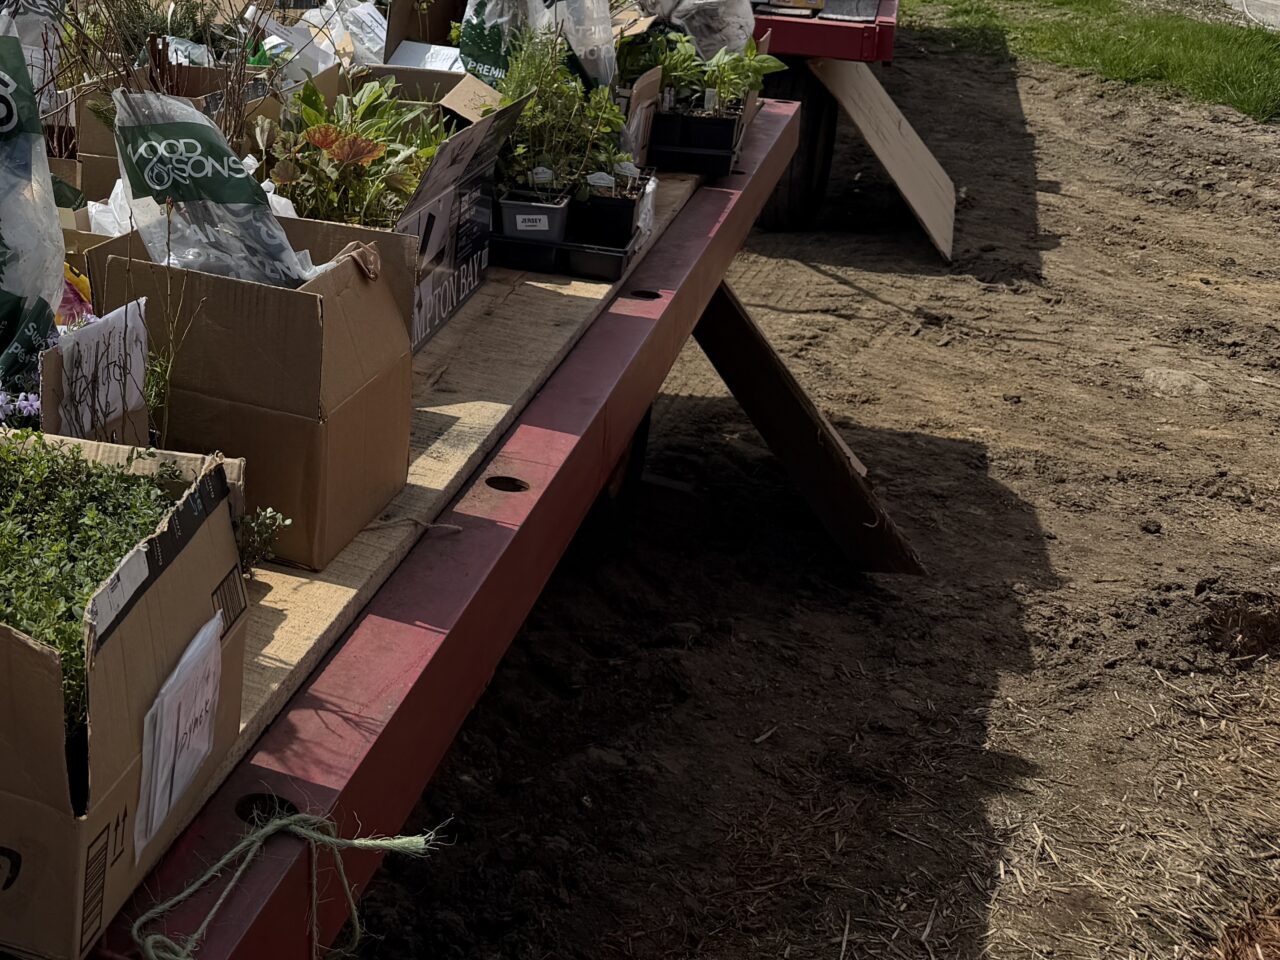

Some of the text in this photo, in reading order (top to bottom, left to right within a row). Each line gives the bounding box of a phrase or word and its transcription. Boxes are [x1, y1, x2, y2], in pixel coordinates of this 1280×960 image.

[467, 61, 507, 79] PREMI
[172, 156, 248, 178] SONS
[413, 250, 481, 347] MPTON BAY
